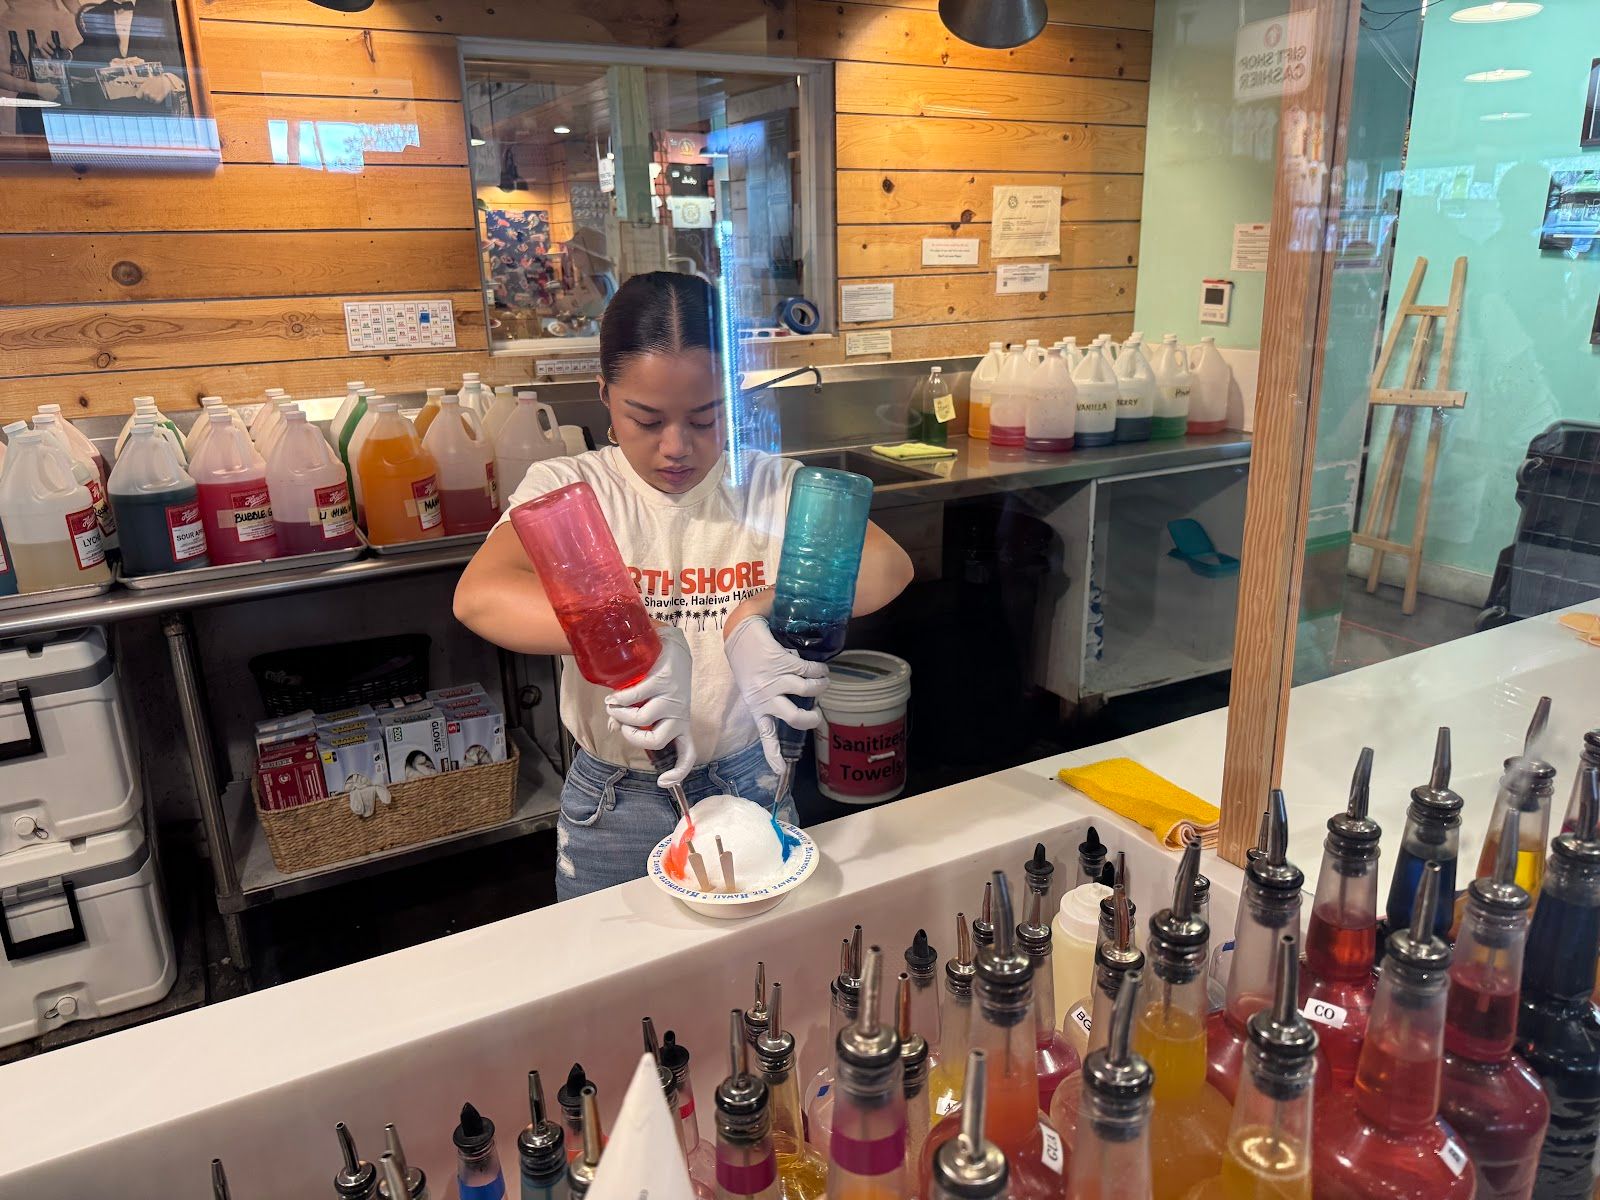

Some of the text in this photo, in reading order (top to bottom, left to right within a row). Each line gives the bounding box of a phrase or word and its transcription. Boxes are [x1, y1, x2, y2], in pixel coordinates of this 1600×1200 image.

[1076, 402, 1108, 411] VANILLA
[234, 509, 266, 524] BUBBLE
[176, 532, 195, 541] SOUR
[627, 561, 766, 595] RTH SHORE
[645, 596, 672, 607] Shav
[691, 595, 730, 606] Haleiwa
[393, 727, 403, 742] 200
[431, 721, 442, 752] GLOVES
[840, 759, 903, 782] Towels
[795, 845, 815, 876] MATSUMOTO
[658, 874, 700, 898] MATSUMOTO
[772, 876, 798, 890] SHAVE
[1313, 1004, 1336, 1020] CO
[1075, 1010, 1092, 1032] BG
